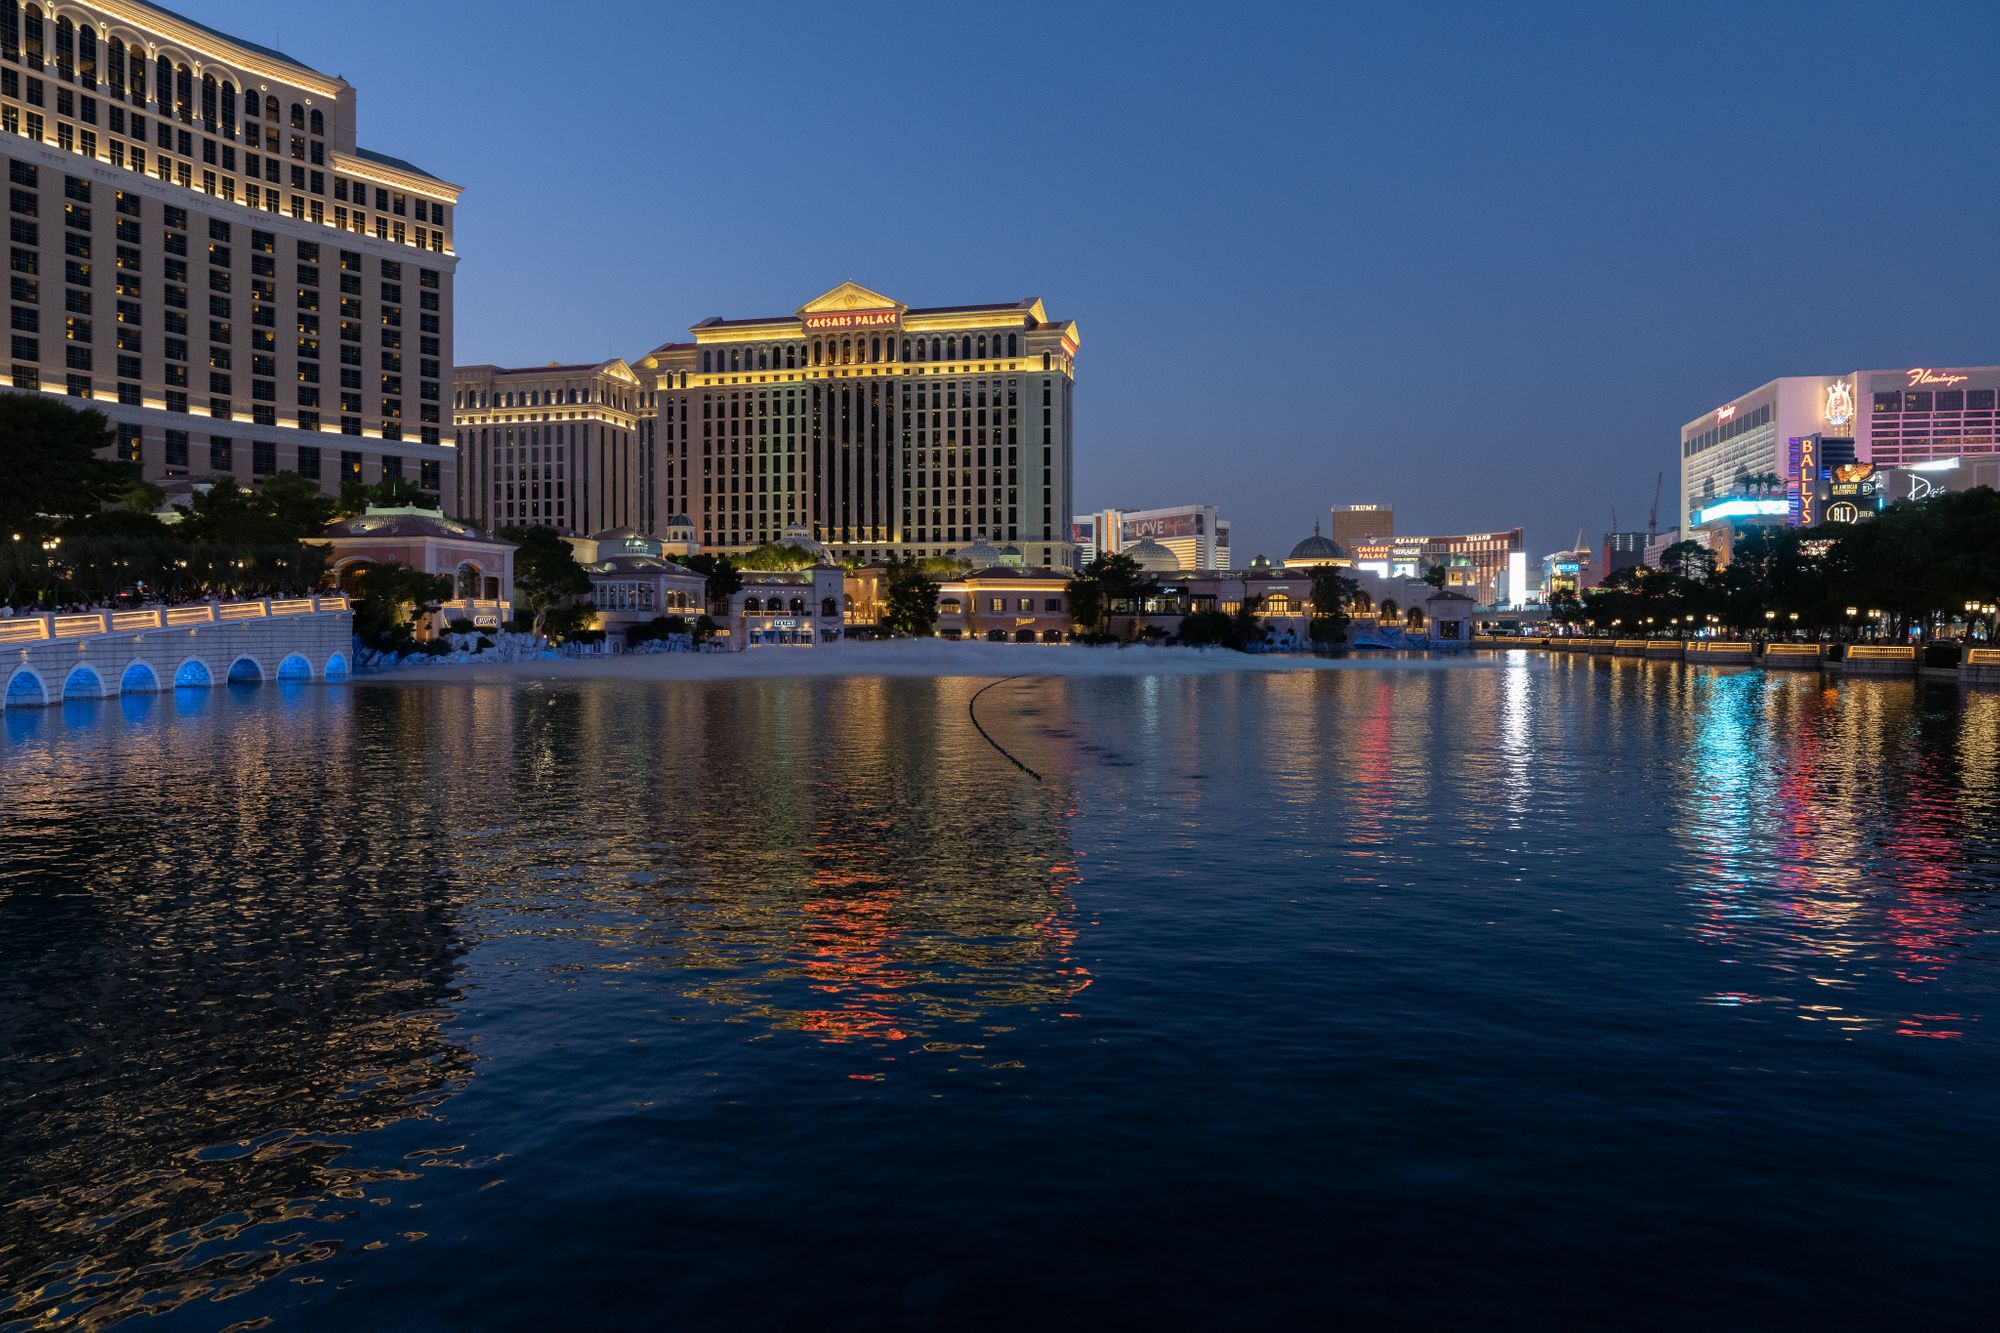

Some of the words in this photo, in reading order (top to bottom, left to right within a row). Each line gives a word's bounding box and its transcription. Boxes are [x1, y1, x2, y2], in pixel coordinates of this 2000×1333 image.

[806, 316, 851, 328] CAESARS
[855, 313, 896, 325] PALACE
[1907, 368, 1968, 387] Flamingo
[1800, 440, 1814, 524] BALLYS
[1833, 507, 1851, 522] BLT
[1135, 520, 1165, 537] LOVE
[1466, 534, 1491, 542] ISLAND
